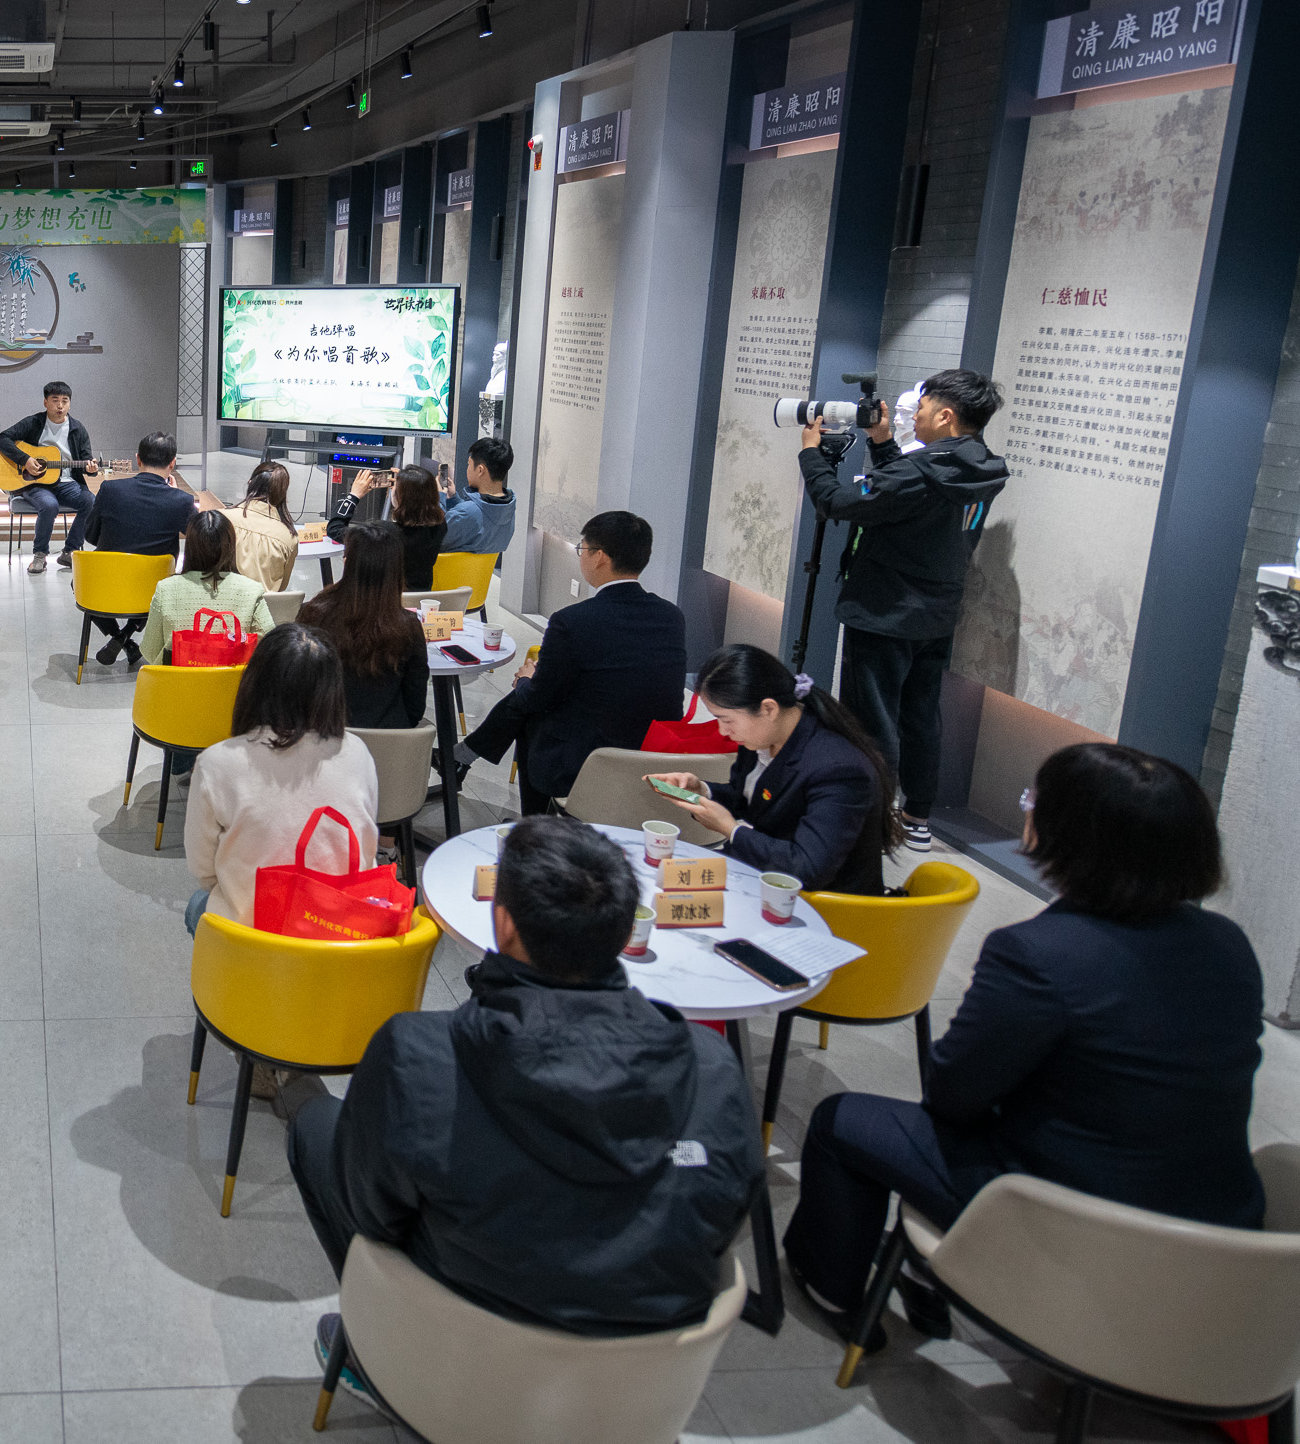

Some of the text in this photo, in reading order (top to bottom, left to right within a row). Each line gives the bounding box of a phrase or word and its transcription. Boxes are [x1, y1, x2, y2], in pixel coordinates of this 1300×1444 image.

[1075, 0, 1225, 57] 清廉昭阳
[1072, 39, 1218, 79] QING LIAN ZHAO YANG
[767, 87, 841, 123] 清廉昭阳
[568, 124, 614, 152] 清廉昭阳
[766, 115, 838, 138] QING LIAN ZHAO YANG
[1041, 287, 1108, 307] 仁慈恤民
[309, 324, 356, 338] 吉他弹唱
[677, 869, 715, 885] 刘佳
[671, 904, 711, 920] 谭冰冰
